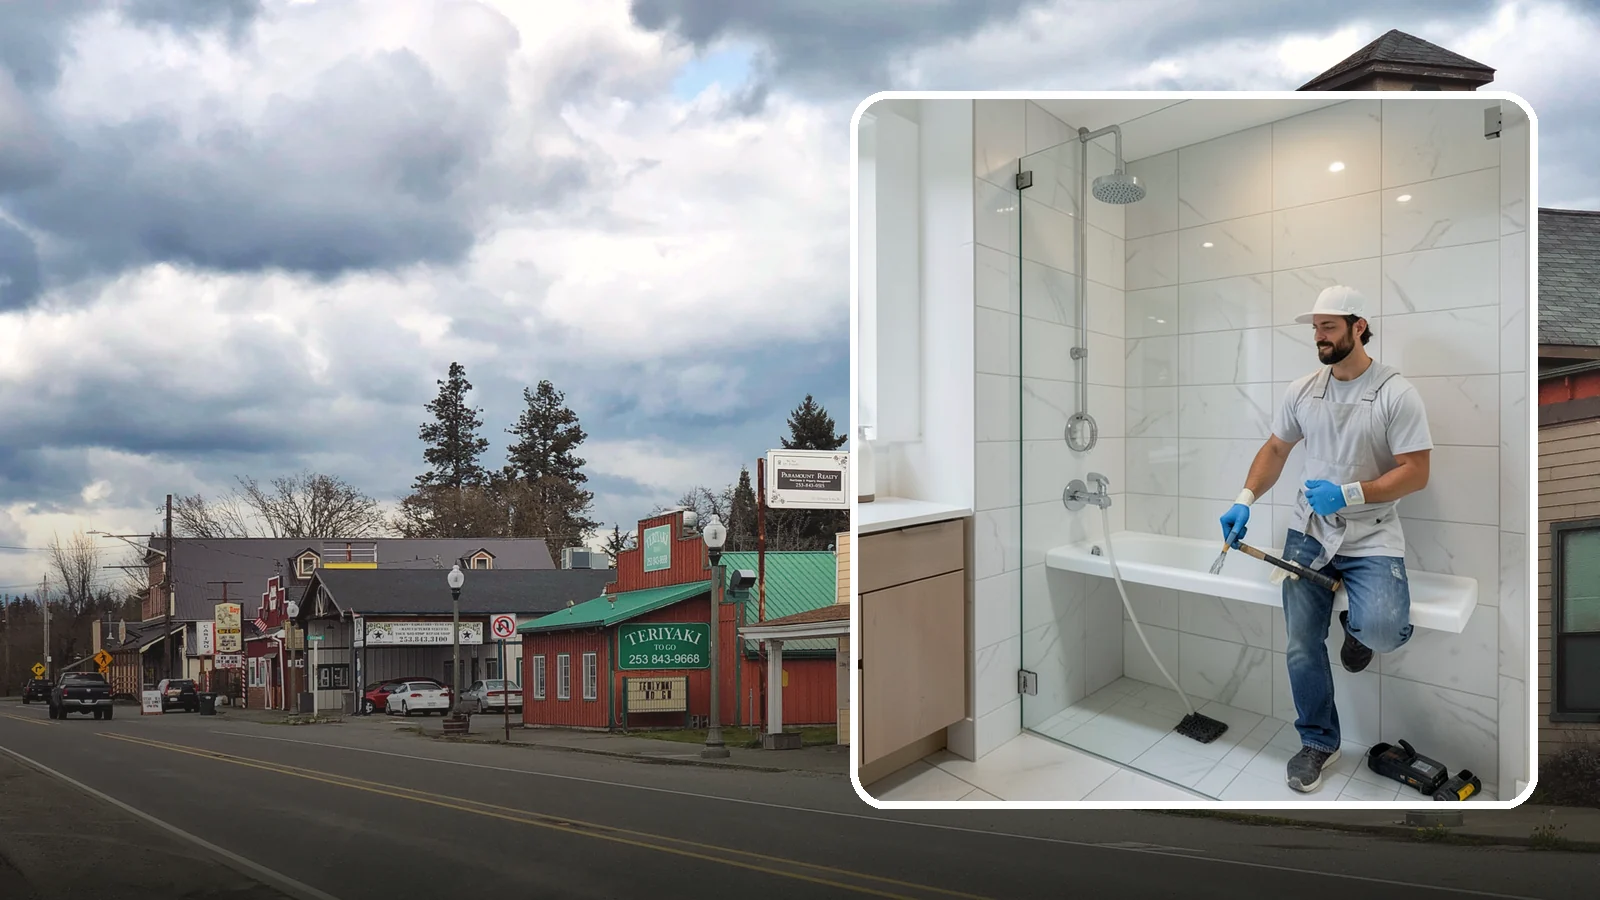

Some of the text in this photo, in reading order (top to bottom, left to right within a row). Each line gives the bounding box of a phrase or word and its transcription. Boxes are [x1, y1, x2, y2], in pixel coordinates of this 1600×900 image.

[625, 628, 702, 646] TERIYAKI
[629, 654, 700, 664] 253 843-9668
